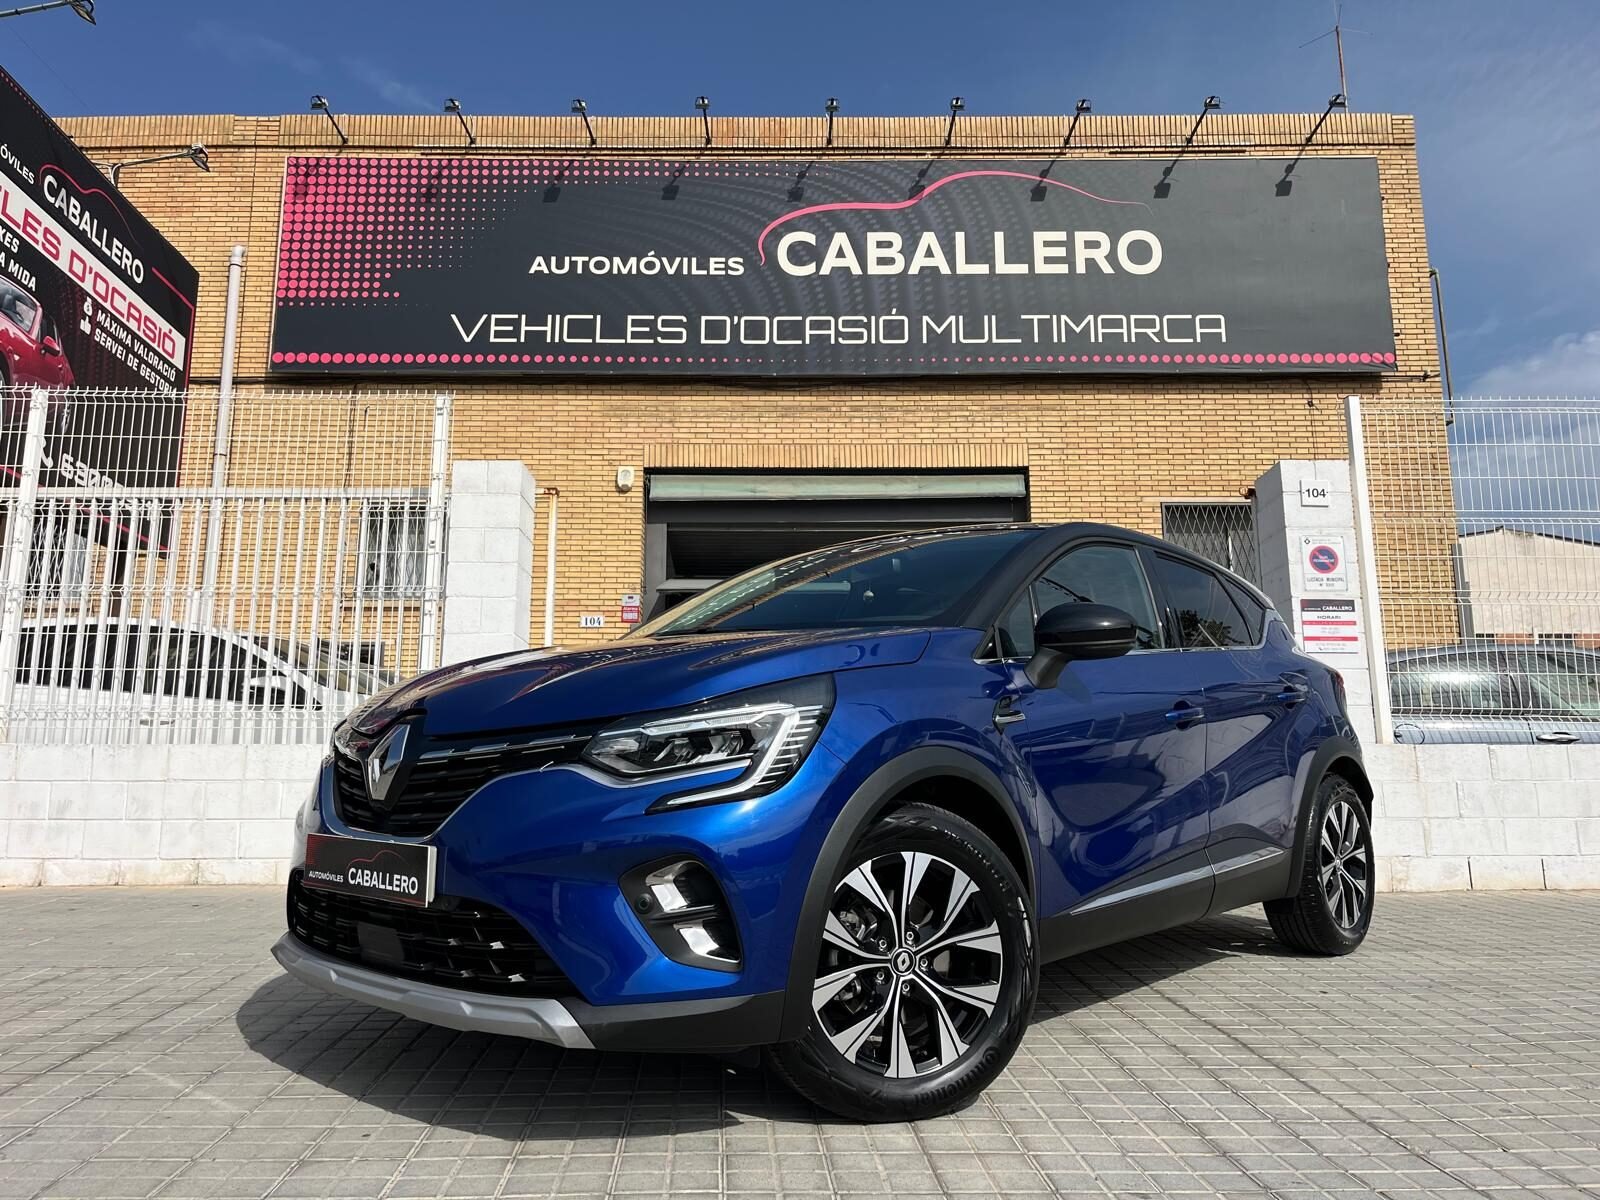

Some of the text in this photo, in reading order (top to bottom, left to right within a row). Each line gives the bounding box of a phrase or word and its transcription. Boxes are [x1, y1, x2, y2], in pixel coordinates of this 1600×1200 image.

[43, 174, 145, 284] CABALLERO
[0, 184, 176, 360] LES D'OCASIÓ
[528, 229, 1164, 277] AUTOMÓVILES CABALLERO
[8, 258, 37, 292] MIDA
[96, 309, 176, 382] MÀXIMA VALORACIÓ
[450, 307, 1227, 345] VEHICLES D'OCASIÓ MULTIMARCA
[94, 328, 126, 361] SERVEI
[127, 353, 140, 372] DE
[1304, 488, 1327, 498] 104
[584, 616, 601, 626] 104
[308, 867, 418, 895] AUTOMÓVILES CABALLERO
